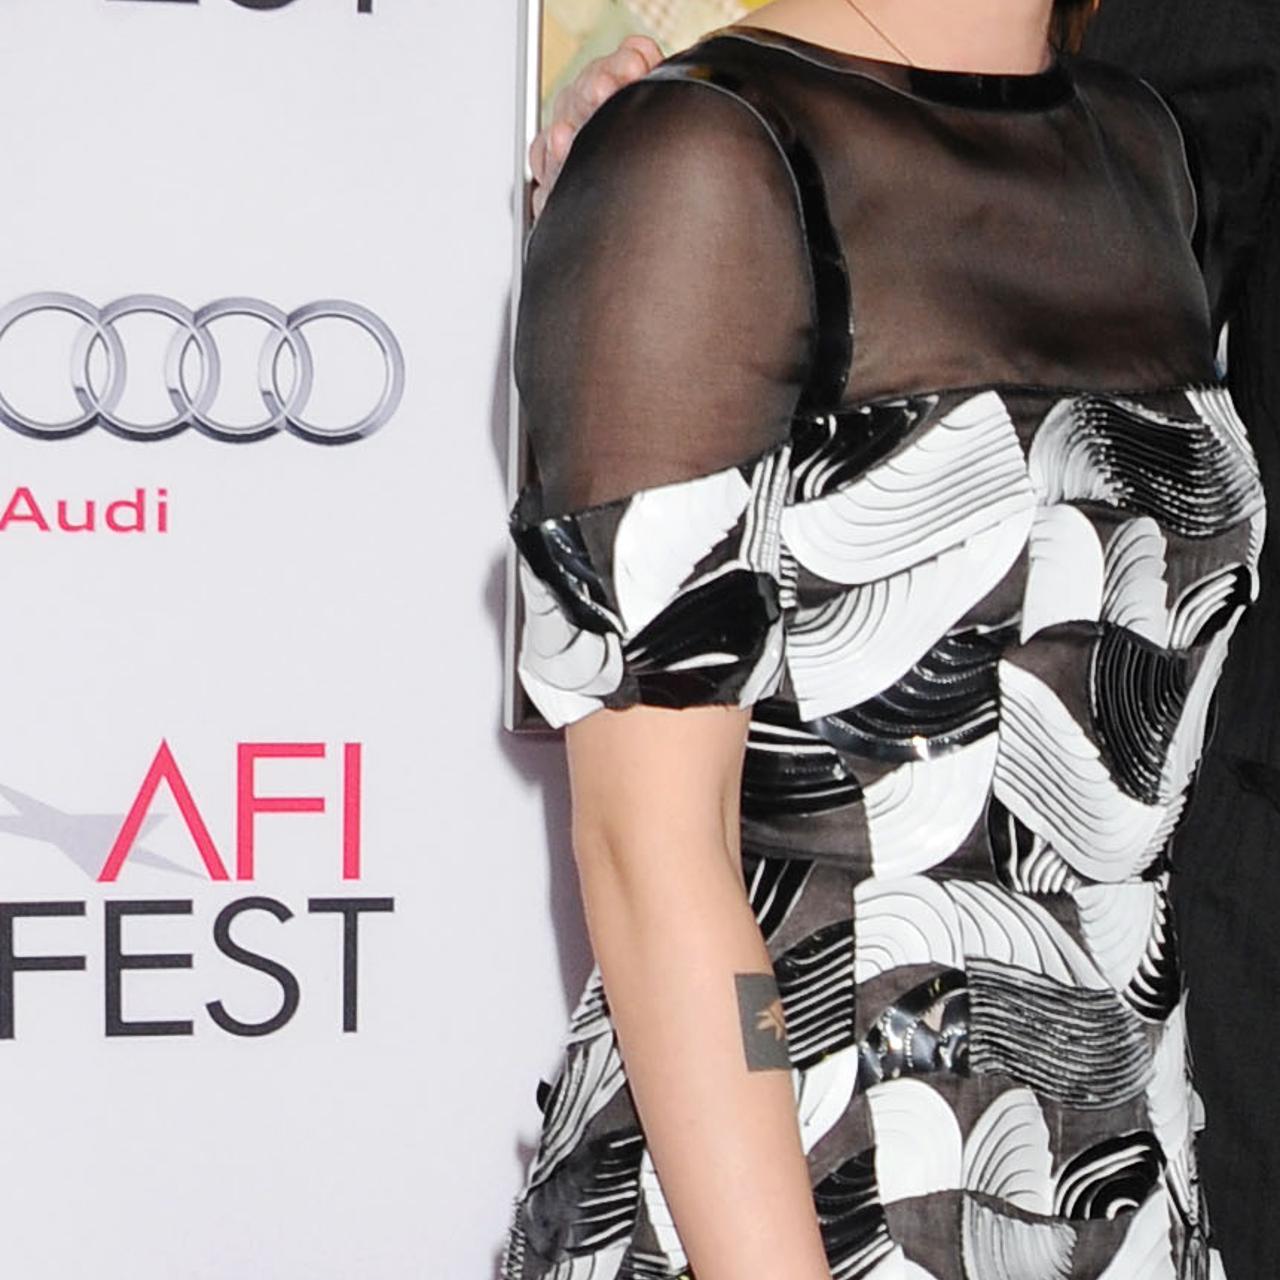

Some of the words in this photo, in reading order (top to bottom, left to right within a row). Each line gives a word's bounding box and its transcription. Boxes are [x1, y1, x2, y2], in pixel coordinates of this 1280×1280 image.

[0, 486, 169, 534] Audi
[97, 737, 362, 883] AFI
[0, 896, 395, 1040] FEST
